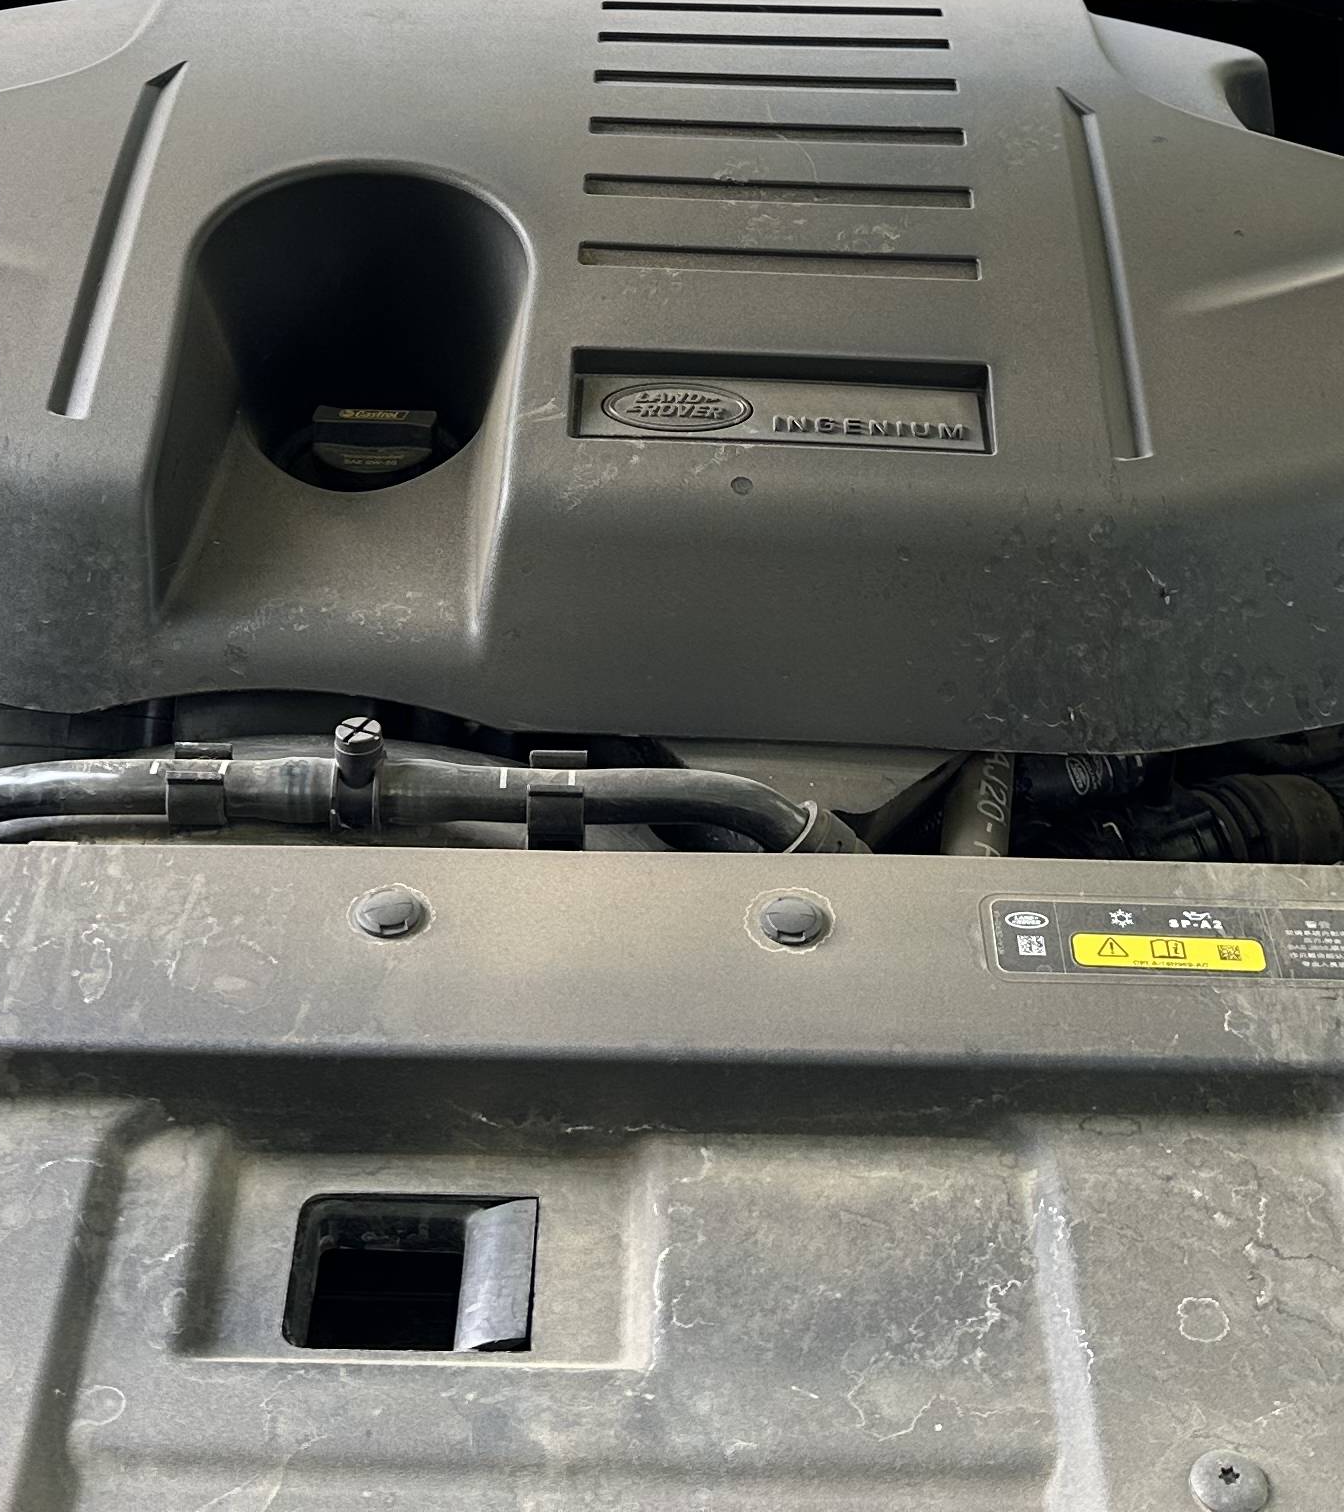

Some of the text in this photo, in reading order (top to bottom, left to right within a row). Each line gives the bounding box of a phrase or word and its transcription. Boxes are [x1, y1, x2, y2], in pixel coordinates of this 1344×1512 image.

[635, 391, 709, 404] LAND
[638, 403, 727, 419] ROVER
[772, 415, 964, 440] INGENIUM
[1168, 918, 1222, 930] SP-A2
